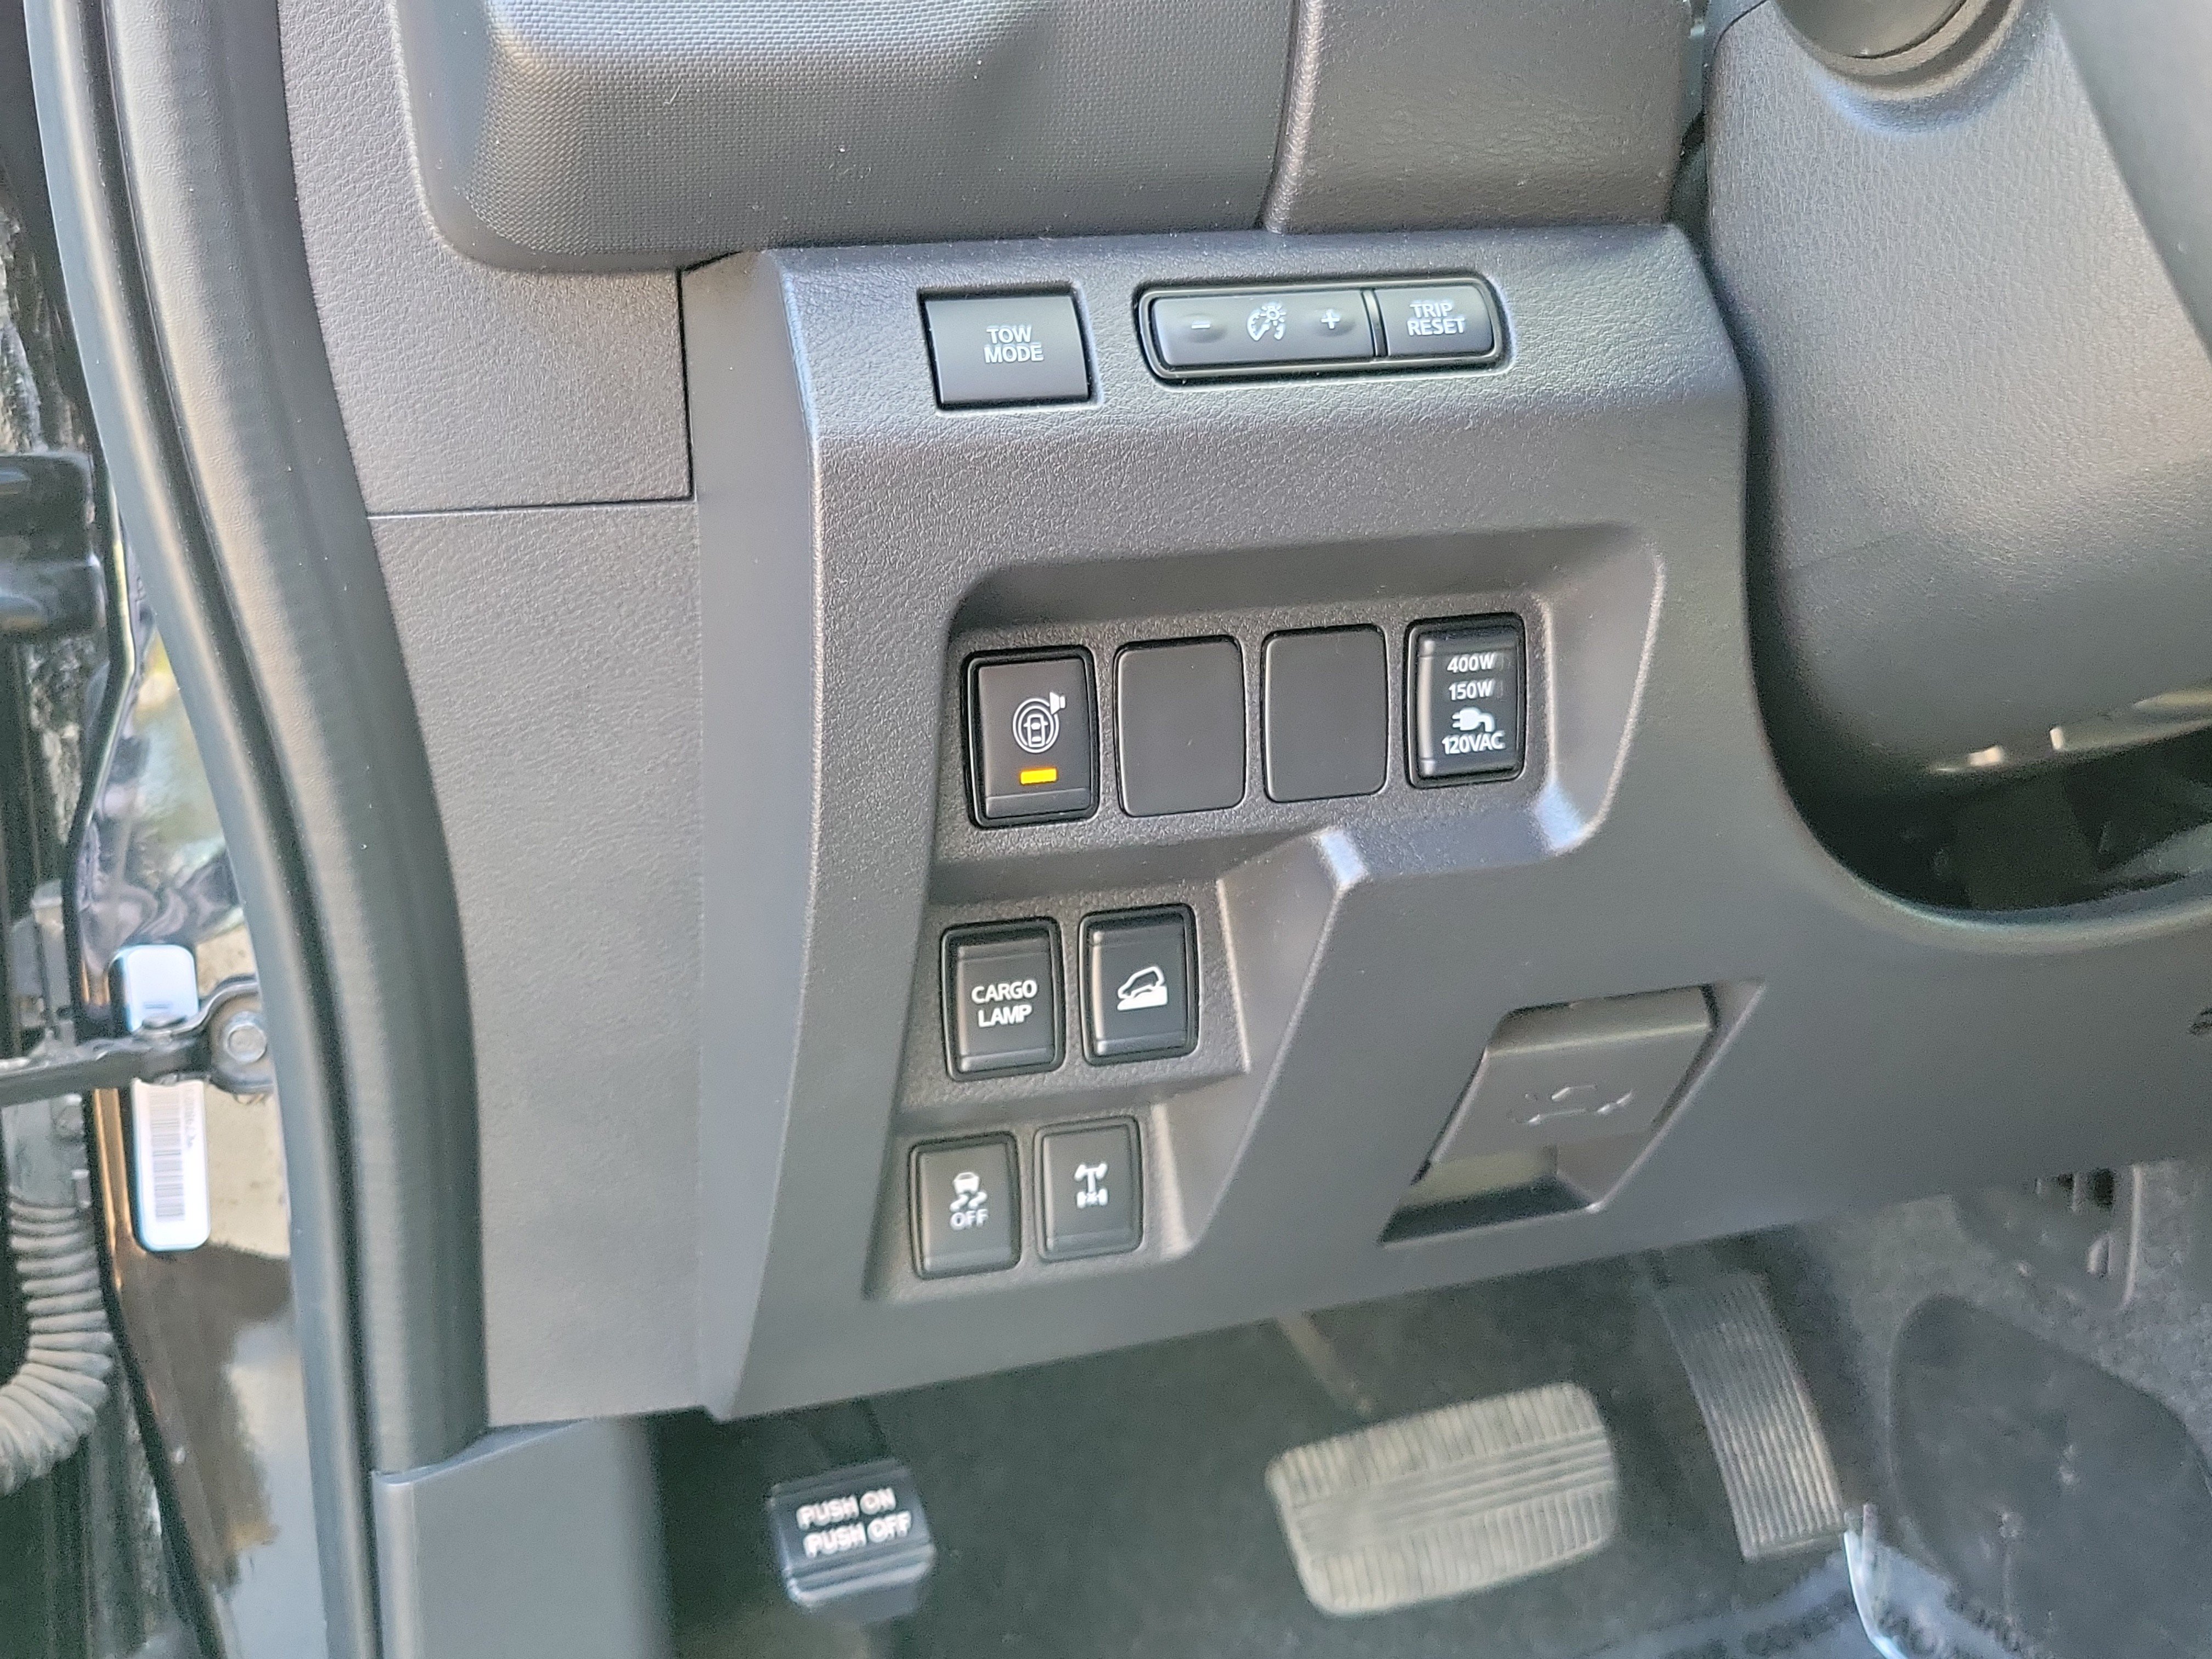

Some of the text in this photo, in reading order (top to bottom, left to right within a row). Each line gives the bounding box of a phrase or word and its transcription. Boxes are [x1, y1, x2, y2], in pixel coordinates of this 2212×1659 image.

[1409, 301, 1453, 318] TRIP
[987, 325, 1032, 343] TOW
[1408, 317, 1465, 336] RESET
[985, 342, 1044, 363] MODE
[1447, 653, 1496, 673] 400W
[1448, 679, 1494, 701] 150W
[1442, 731, 1505, 754] 120VAC
[972, 979, 1037, 1004] CARGO
[978, 1005, 1032, 1028] LAMP
[951, 1209, 988, 1230] OFF
[797, 1487, 896, 1530] PUSH ON
[803, 1511, 912, 1559] PUSH OFF
